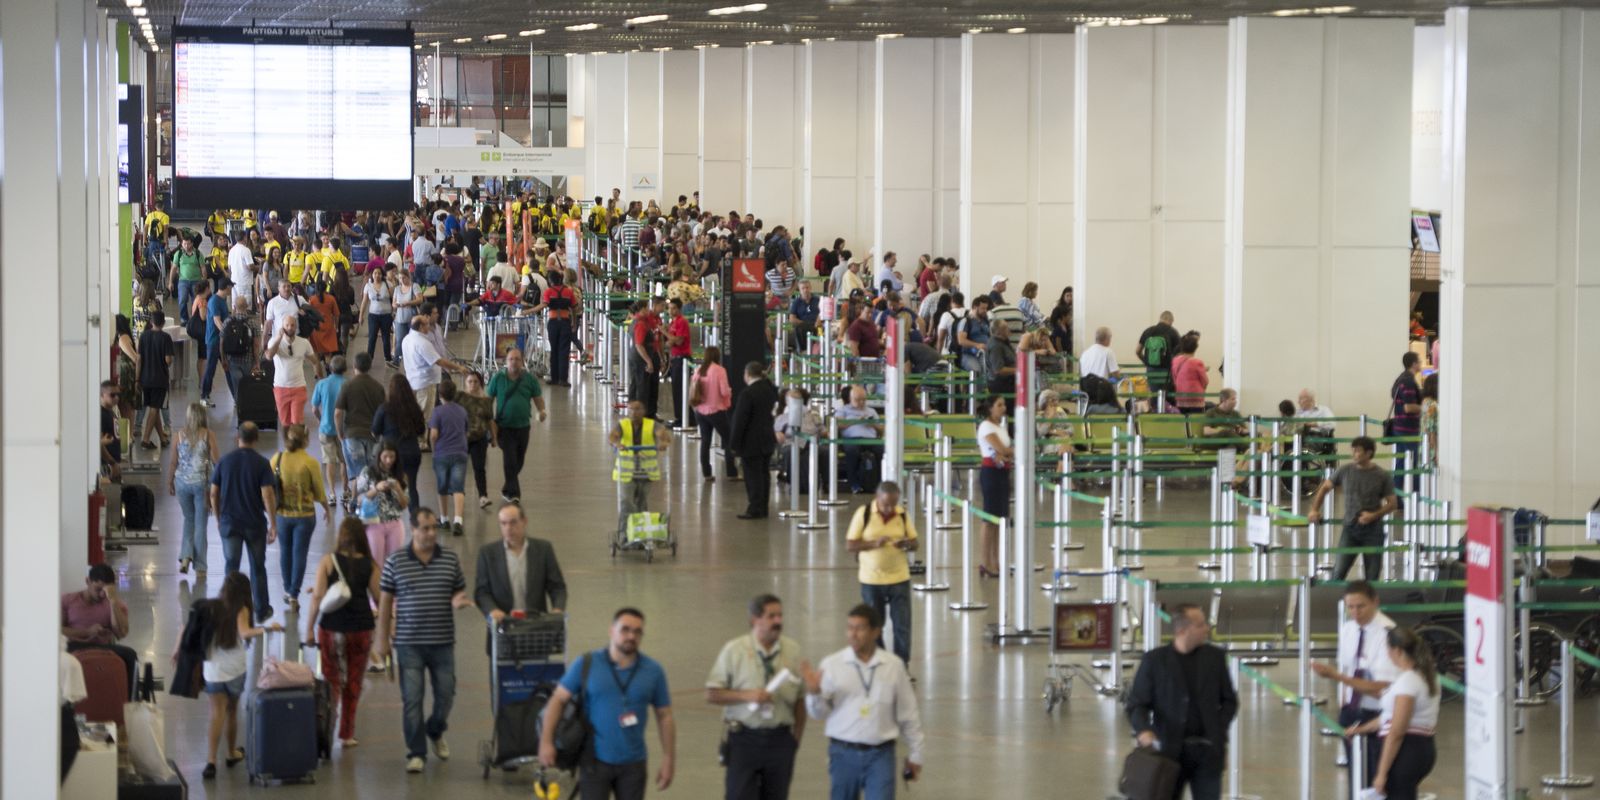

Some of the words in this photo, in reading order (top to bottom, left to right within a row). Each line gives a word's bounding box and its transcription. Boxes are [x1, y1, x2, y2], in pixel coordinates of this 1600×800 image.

[242, 27, 283, 35] PARTIDAS
[289, 28, 344, 36] DEPARTURES
[1475, 617, 1484, 665] 2
